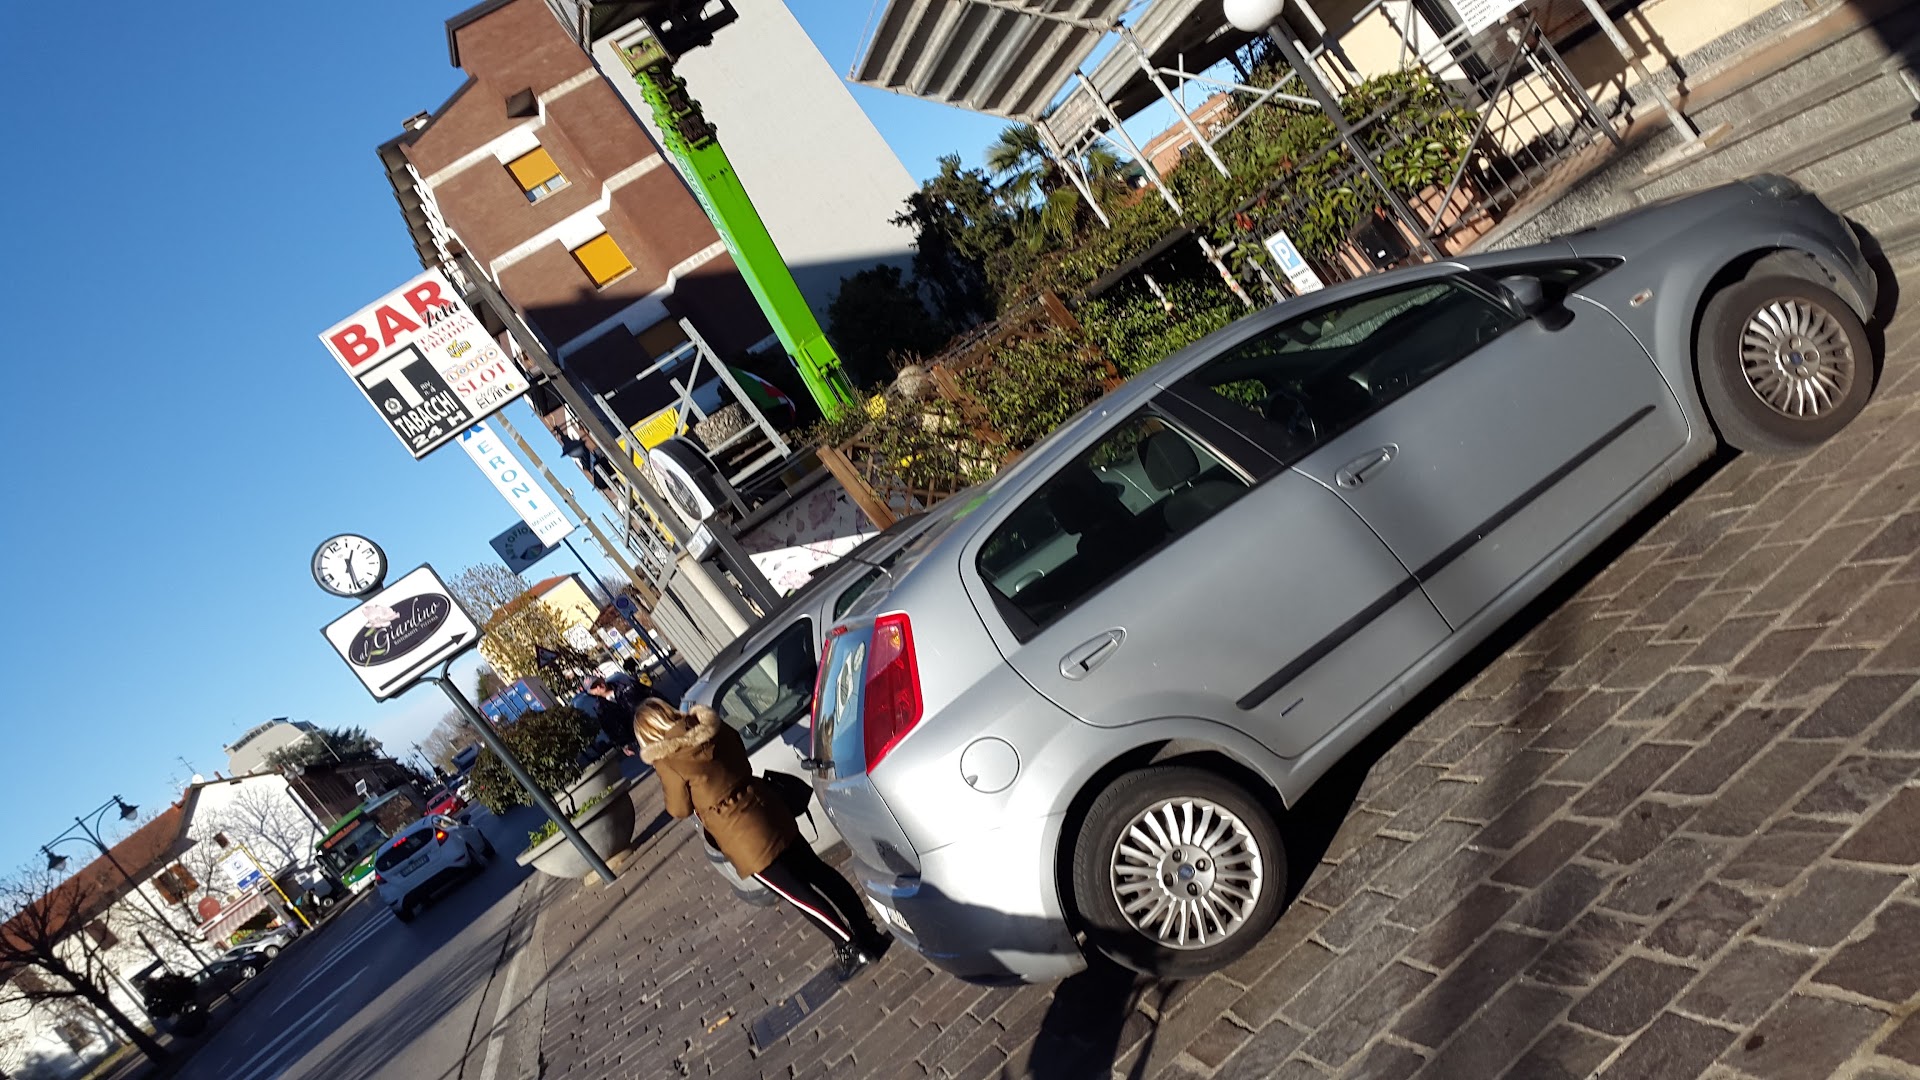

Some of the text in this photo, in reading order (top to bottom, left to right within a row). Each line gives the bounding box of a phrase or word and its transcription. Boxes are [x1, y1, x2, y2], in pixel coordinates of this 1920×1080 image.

[1274, 242, 1292, 268] P
[329, 280, 452, 368] BAR
[417, 314, 469, 346] TAVOLA
[420, 300, 461, 329] Zeta
[422, 320, 475, 353] FREDDA
[457, 359, 507, 398] SLOT
[393, 389, 460, 439] TABACCHI
[412, 410, 467, 450] 24 H
[359, 597, 441, 661] al Giardino
